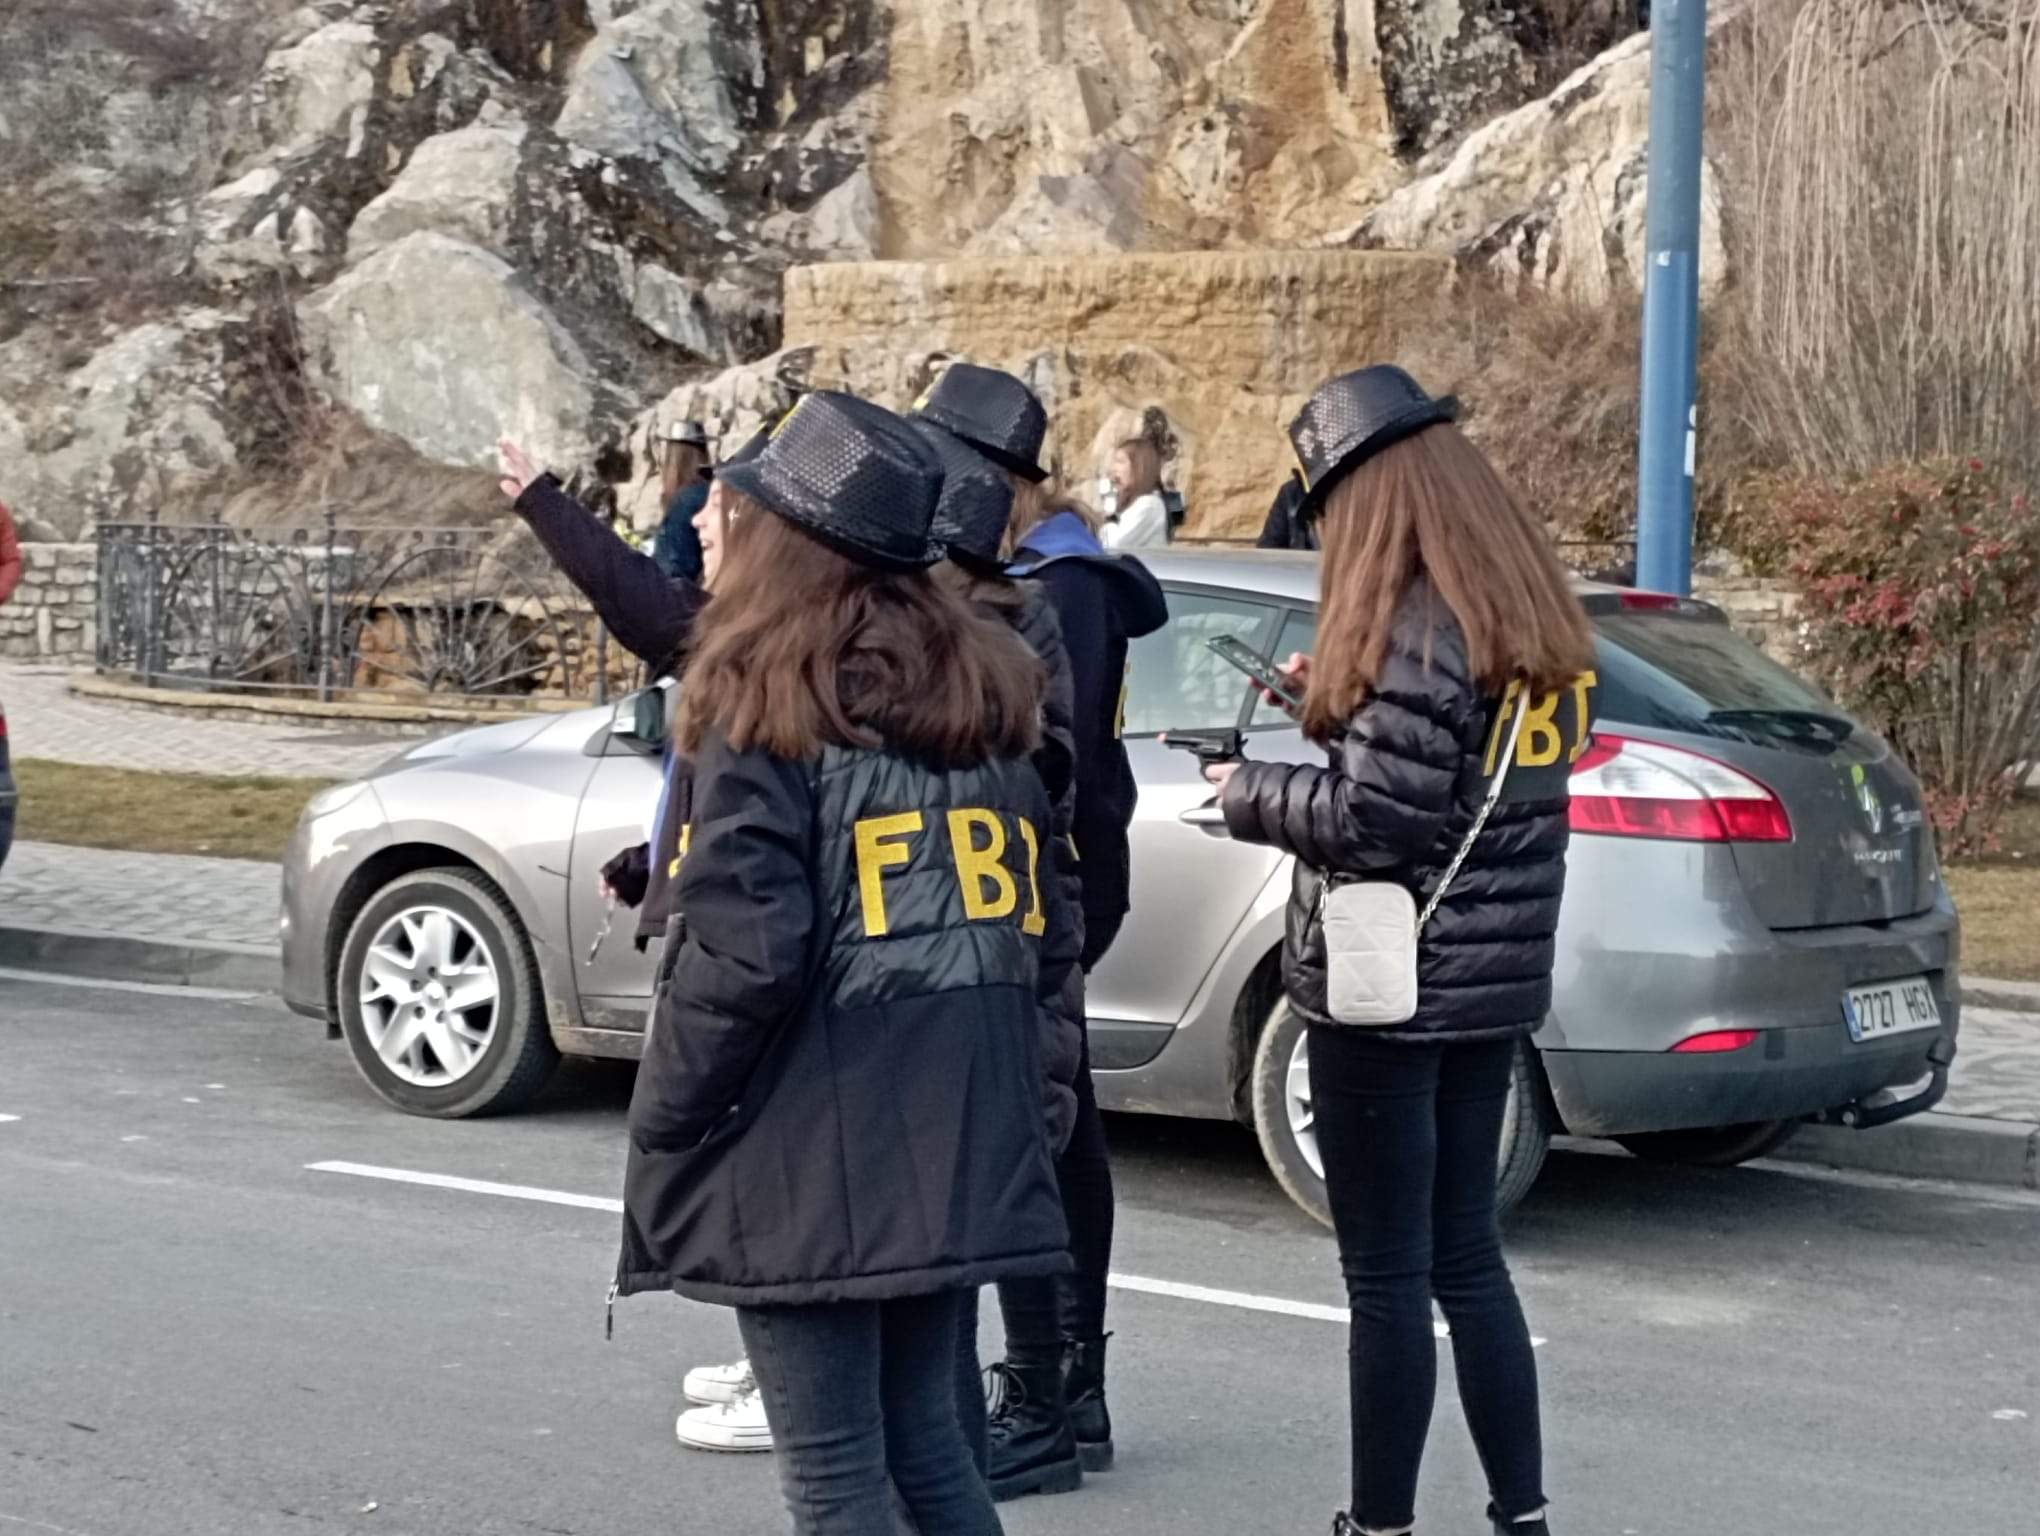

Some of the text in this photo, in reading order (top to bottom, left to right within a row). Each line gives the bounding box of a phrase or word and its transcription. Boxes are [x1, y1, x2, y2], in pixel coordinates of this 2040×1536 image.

[1483, 670, 1597, 776] FBI
[855, 808, 1045, 936] FBI
[1853, 984, 1939, 1032] 2727 HGX
